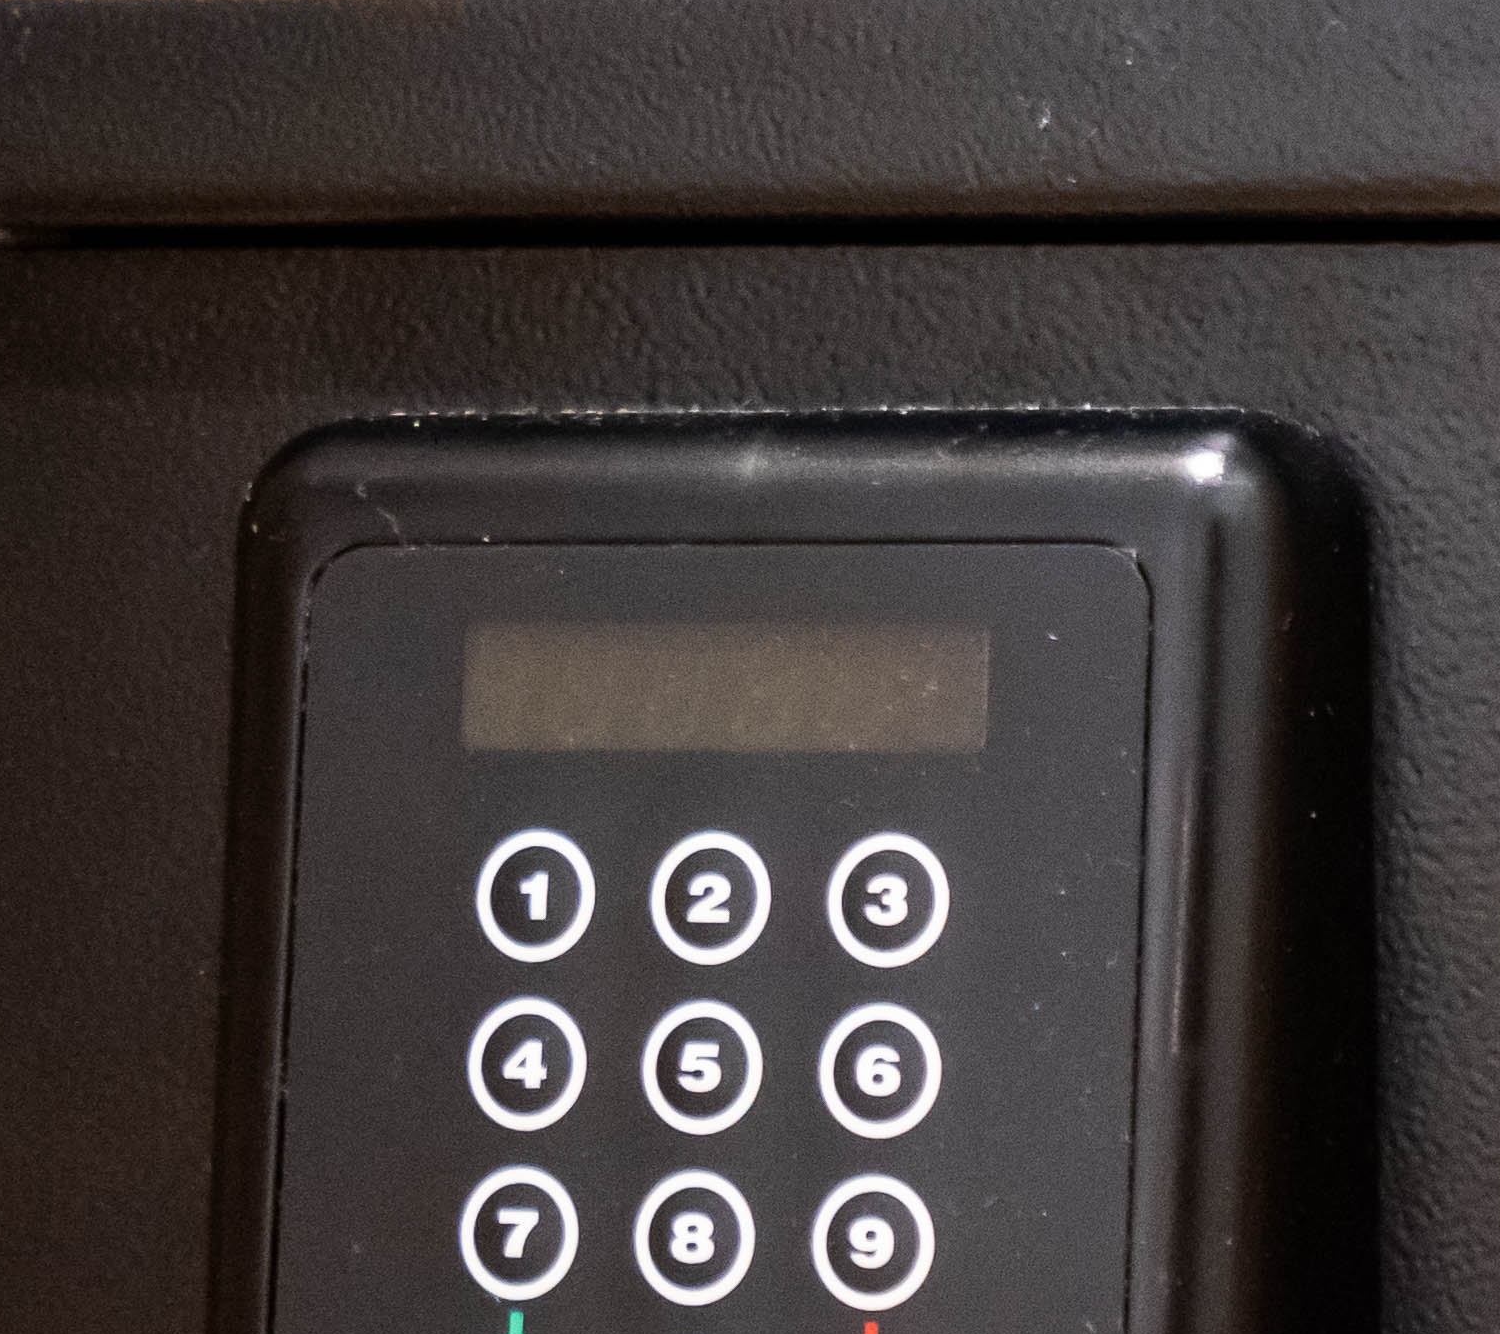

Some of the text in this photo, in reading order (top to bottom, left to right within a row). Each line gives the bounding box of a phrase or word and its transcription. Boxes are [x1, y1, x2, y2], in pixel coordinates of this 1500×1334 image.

[518, 870, 909, 926] 1 2 3
[502, 1038, 902, 1097] 4 5 6
[497, 1207, 895, 1270] 7 8 9
